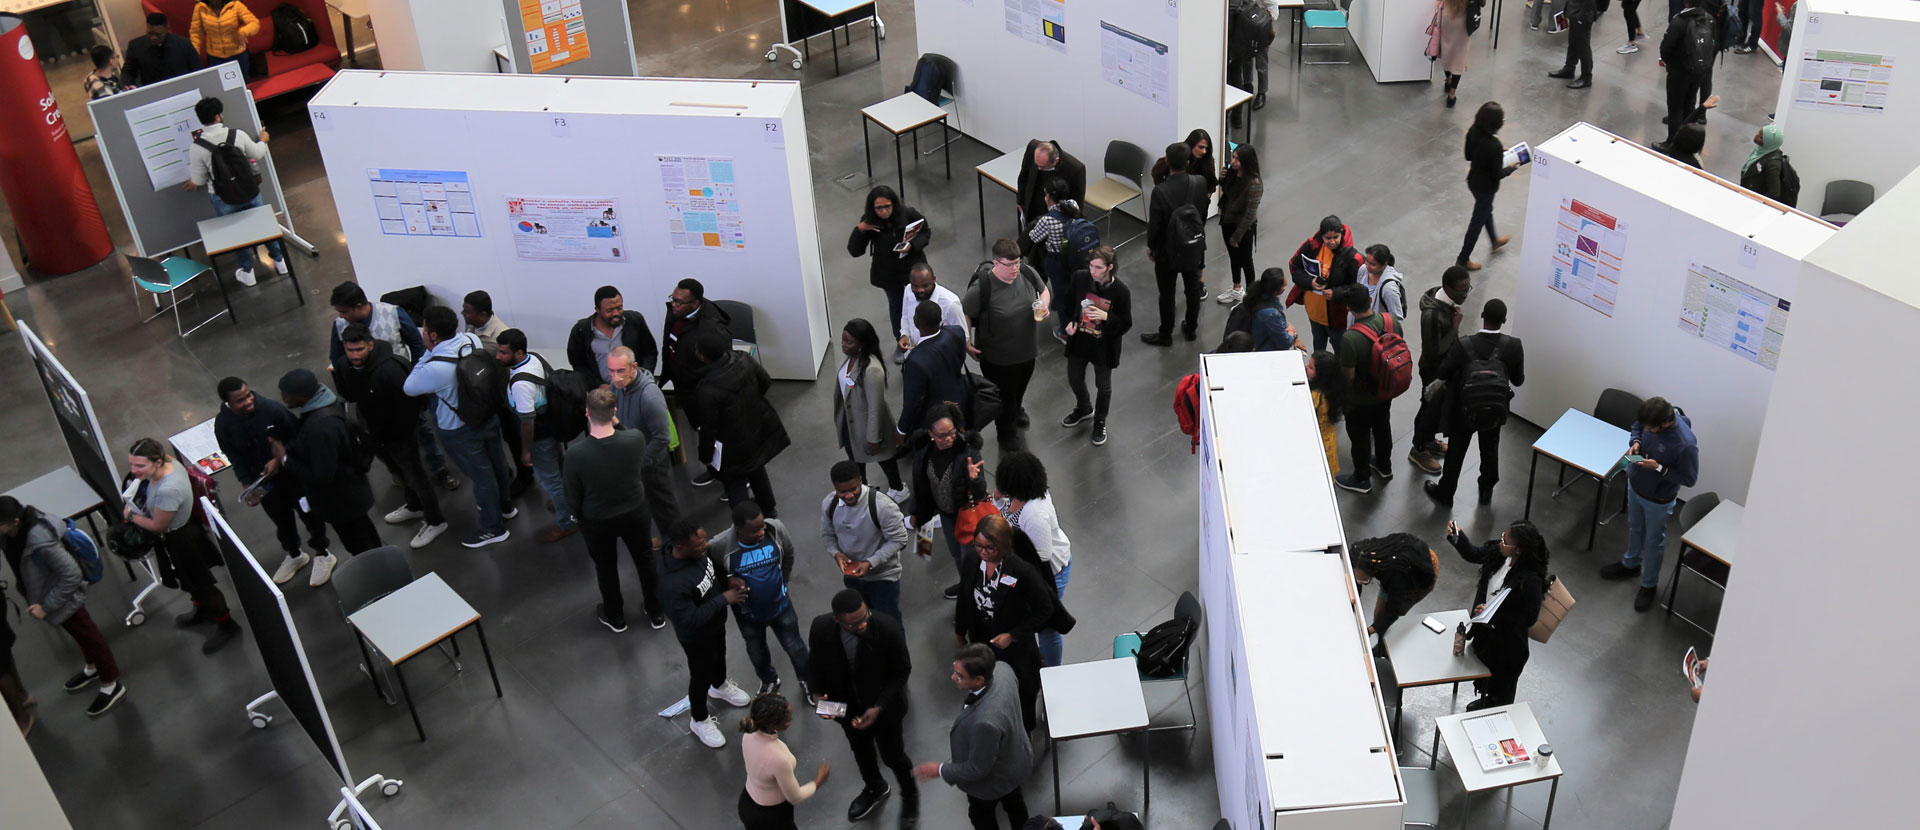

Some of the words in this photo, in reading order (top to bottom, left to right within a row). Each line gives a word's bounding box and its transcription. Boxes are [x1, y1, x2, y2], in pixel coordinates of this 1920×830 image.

[1809, 16, 1819, 24] E6
[224, 71, 236, 80] C3
[313, 112, 326, 120] F4
[554, 118, 566, 127] F3
[765, 123, 778, 132] F2
[1533, 154, 1548, 166] E10
[1743, 244, 1757, 256] E11
[740, 545, 774, 567] ABP
